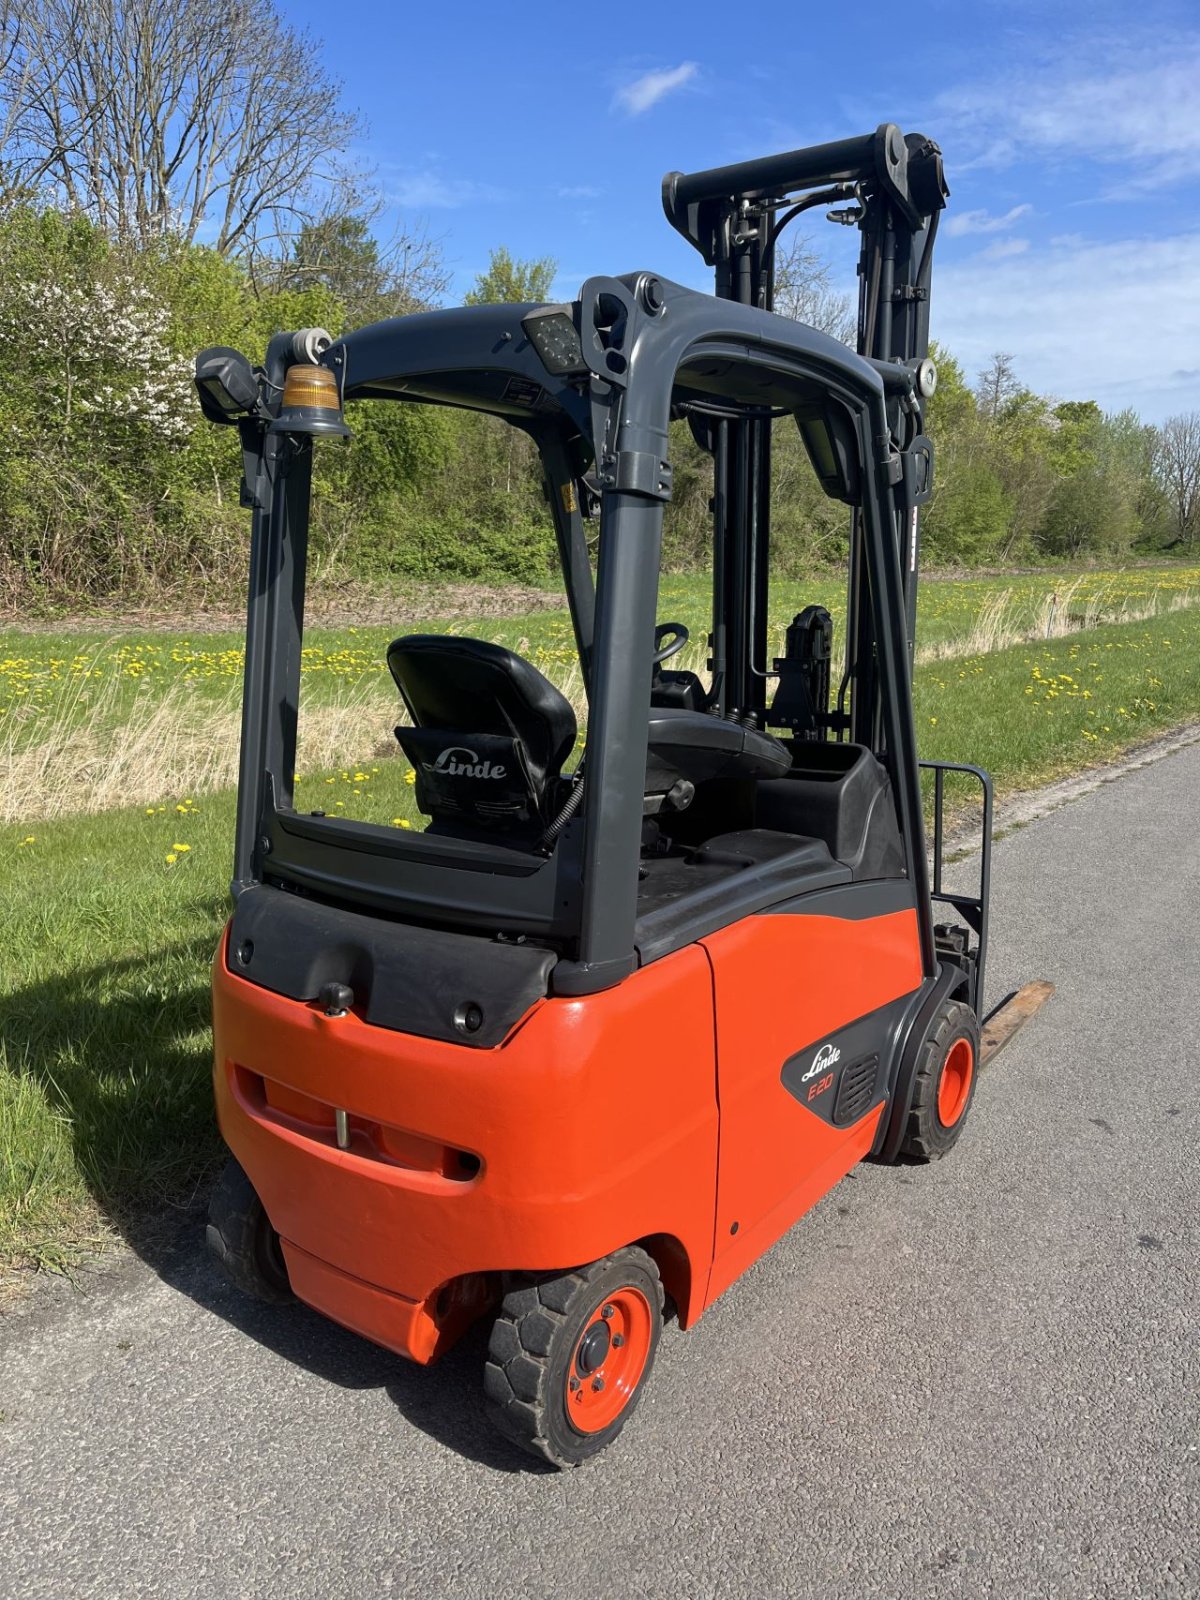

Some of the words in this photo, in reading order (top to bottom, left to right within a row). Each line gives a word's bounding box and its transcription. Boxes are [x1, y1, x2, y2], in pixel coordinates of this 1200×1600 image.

[422, 747, 507, 779] Linde
[801, 1044, 841, 1082] Linde
[807, 1072, 835, 1102] E20
